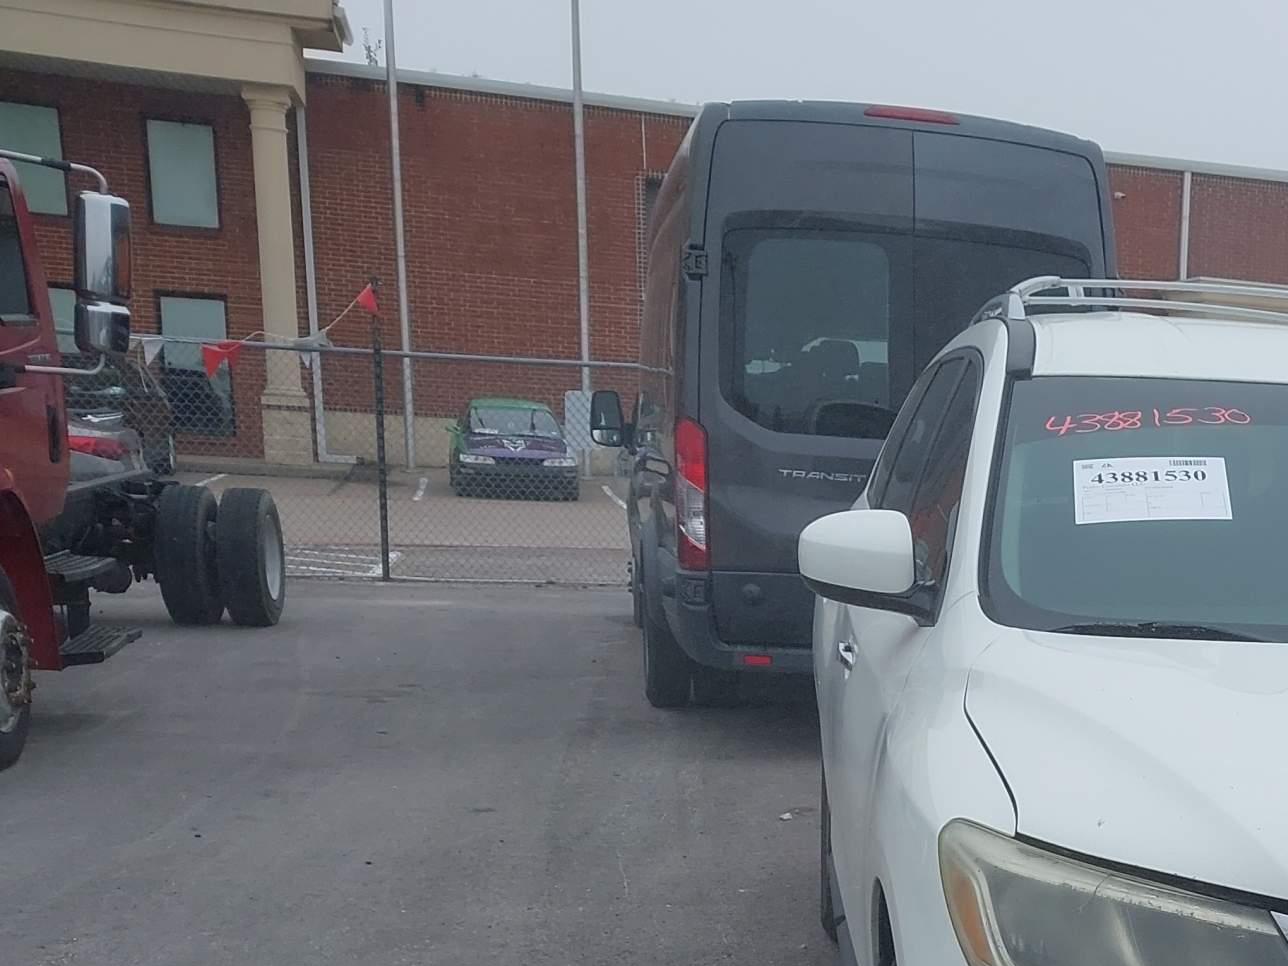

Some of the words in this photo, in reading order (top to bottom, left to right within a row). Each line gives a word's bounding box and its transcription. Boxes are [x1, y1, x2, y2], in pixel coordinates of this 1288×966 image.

[1045, 406, 1251, 436] 43881530
[778, 468, 867, 483] TRANSIT
[1090, 469, 1207, 485] 43881530
